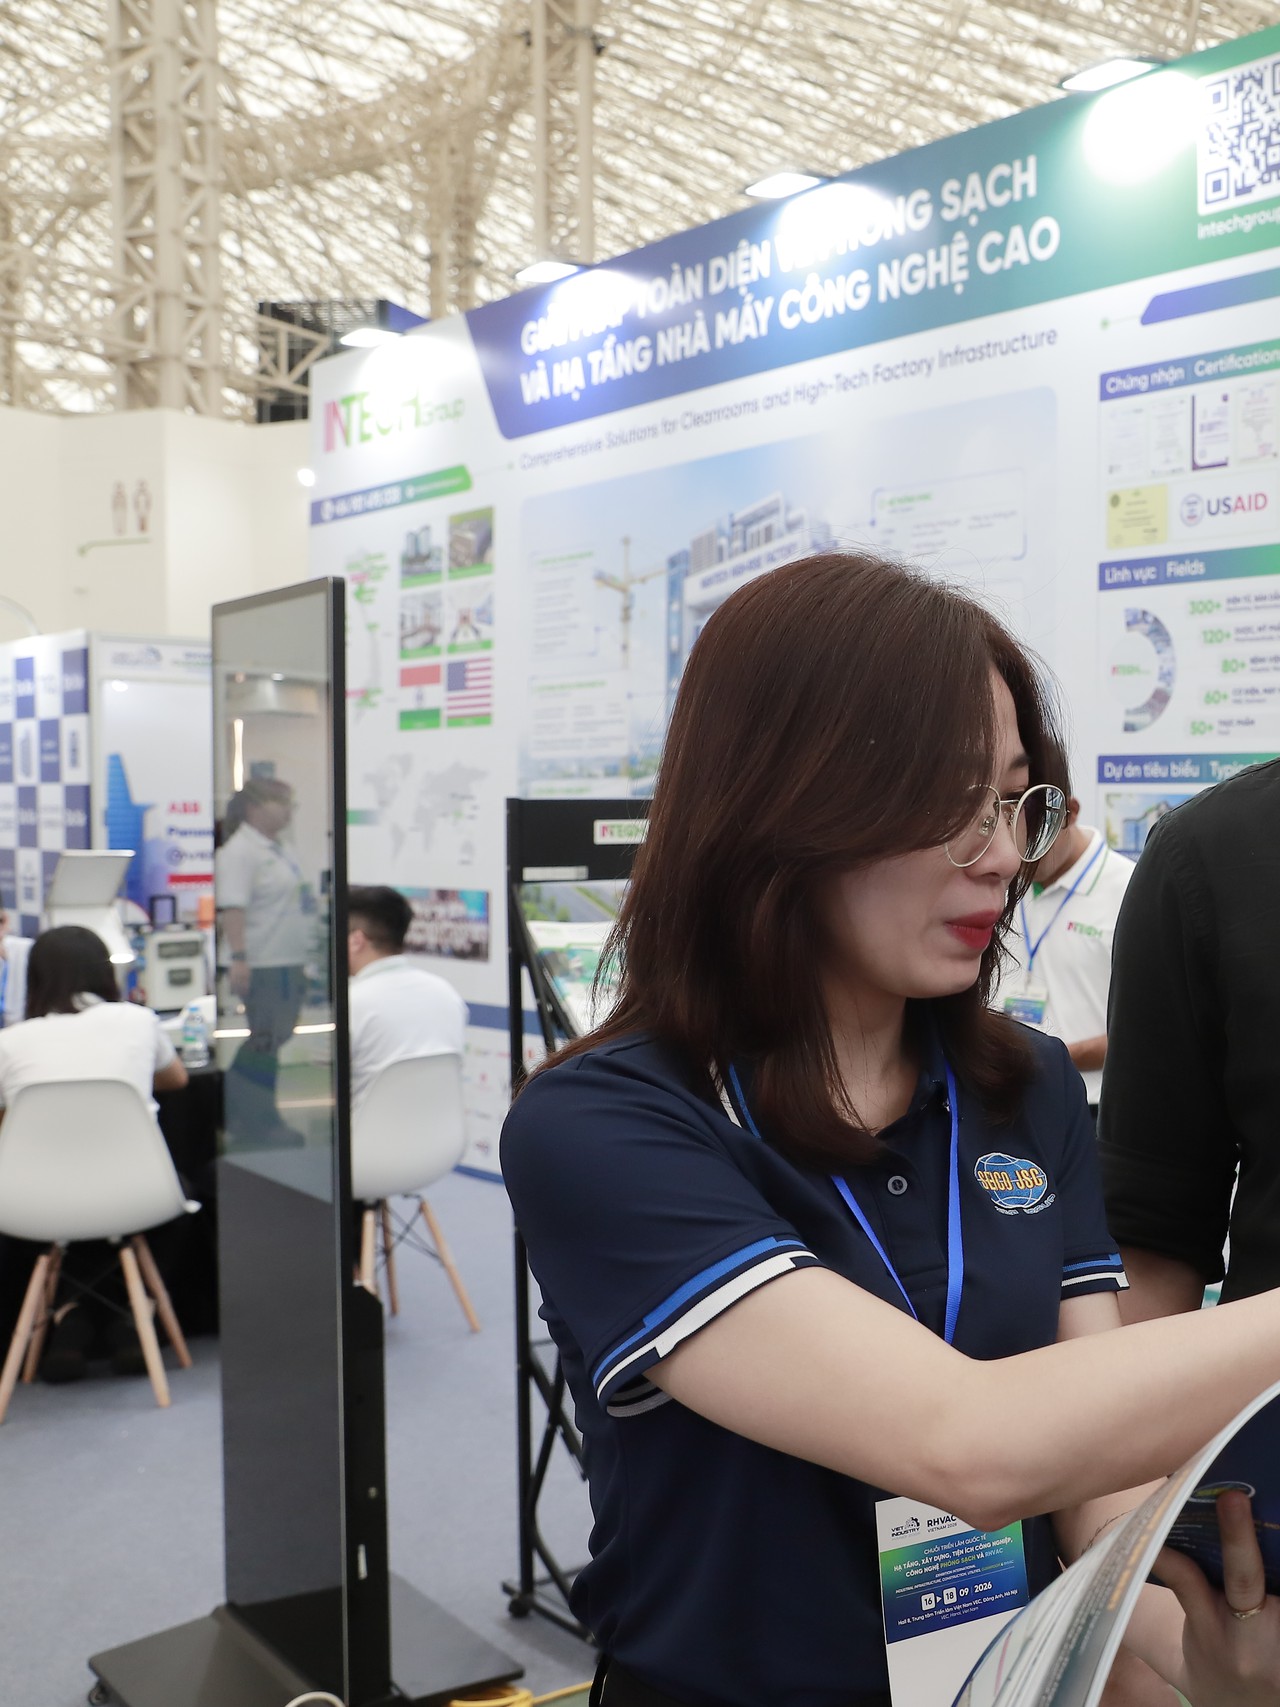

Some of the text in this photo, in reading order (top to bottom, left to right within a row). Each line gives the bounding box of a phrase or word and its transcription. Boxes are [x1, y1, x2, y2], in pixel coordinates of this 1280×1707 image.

[708, 239, 771, 297] DIỆN
[940, 153, 1039, 228] SẠCH
[520, 359, 550, 405] VÀ
[552, 356, 585, 402] HẠ
[587, 333, 653, 385] TẦNG
[656, 311, 712, 366] NHÀ
[715, 291, 775, 349] MÁY
[778, 268, 872, 330] CÔNG
[877, 224, 969, 303] NGHỆ
[976, 215, 1061, 276] CAO
[1105, 372, 1149, 396] Chứng
[1150, 363, 1184, 387] nhận
[519, 327, 1058, 471] Comprehensive Solutions for Cleanrooms and High-Tech Factory Infrastructure
[1206, 492, 1269, 516] USAID
[1105, 560, 1206, 585] Lĩnh vực Fields
[1189, 598, 1222, 616] 300+
[1202, 628, 1231, 645] 120+
[1221, 656, 1246, 674] 80+
[1203, 689, 1229, 706] 60+
[1189, 720, 1214, 736] 50+
[1103, 761, 1123, 780] Dự
[1124, 761, 1141, 776] án
[1143, 760, 1169, 777] tiêu
[977, 1167, 1044, 1191] SEICO JSC
[891, 1514, 957, 1533] VIET RHVAC
[891, 1527, 920, 1537] INDUSTRY
[927, 1525, 947, 1533] VIETNAM
[893, 1563, 903, 1572] HẠ
[921, 1555, 933, 1565] XÂY
[974, 1541, 992, 1551] CÔNG
[905, 1567, 924, 1578] CÔNG
[923, 1562, 940, 1573] NGHỆ
[940, 1558, 960, 1569] PHÒNG
[960, 1554, 977, 1564] SẠCH
[976, 1551, 985, 1560] VÀ
[924, 1581, 993, 1606] 16 18 09 2026
[898, 1618, 907, 1626] Hall
[911, 1614, 925, 1623] Trung
[961, 1601, 973, 1610] Nam
